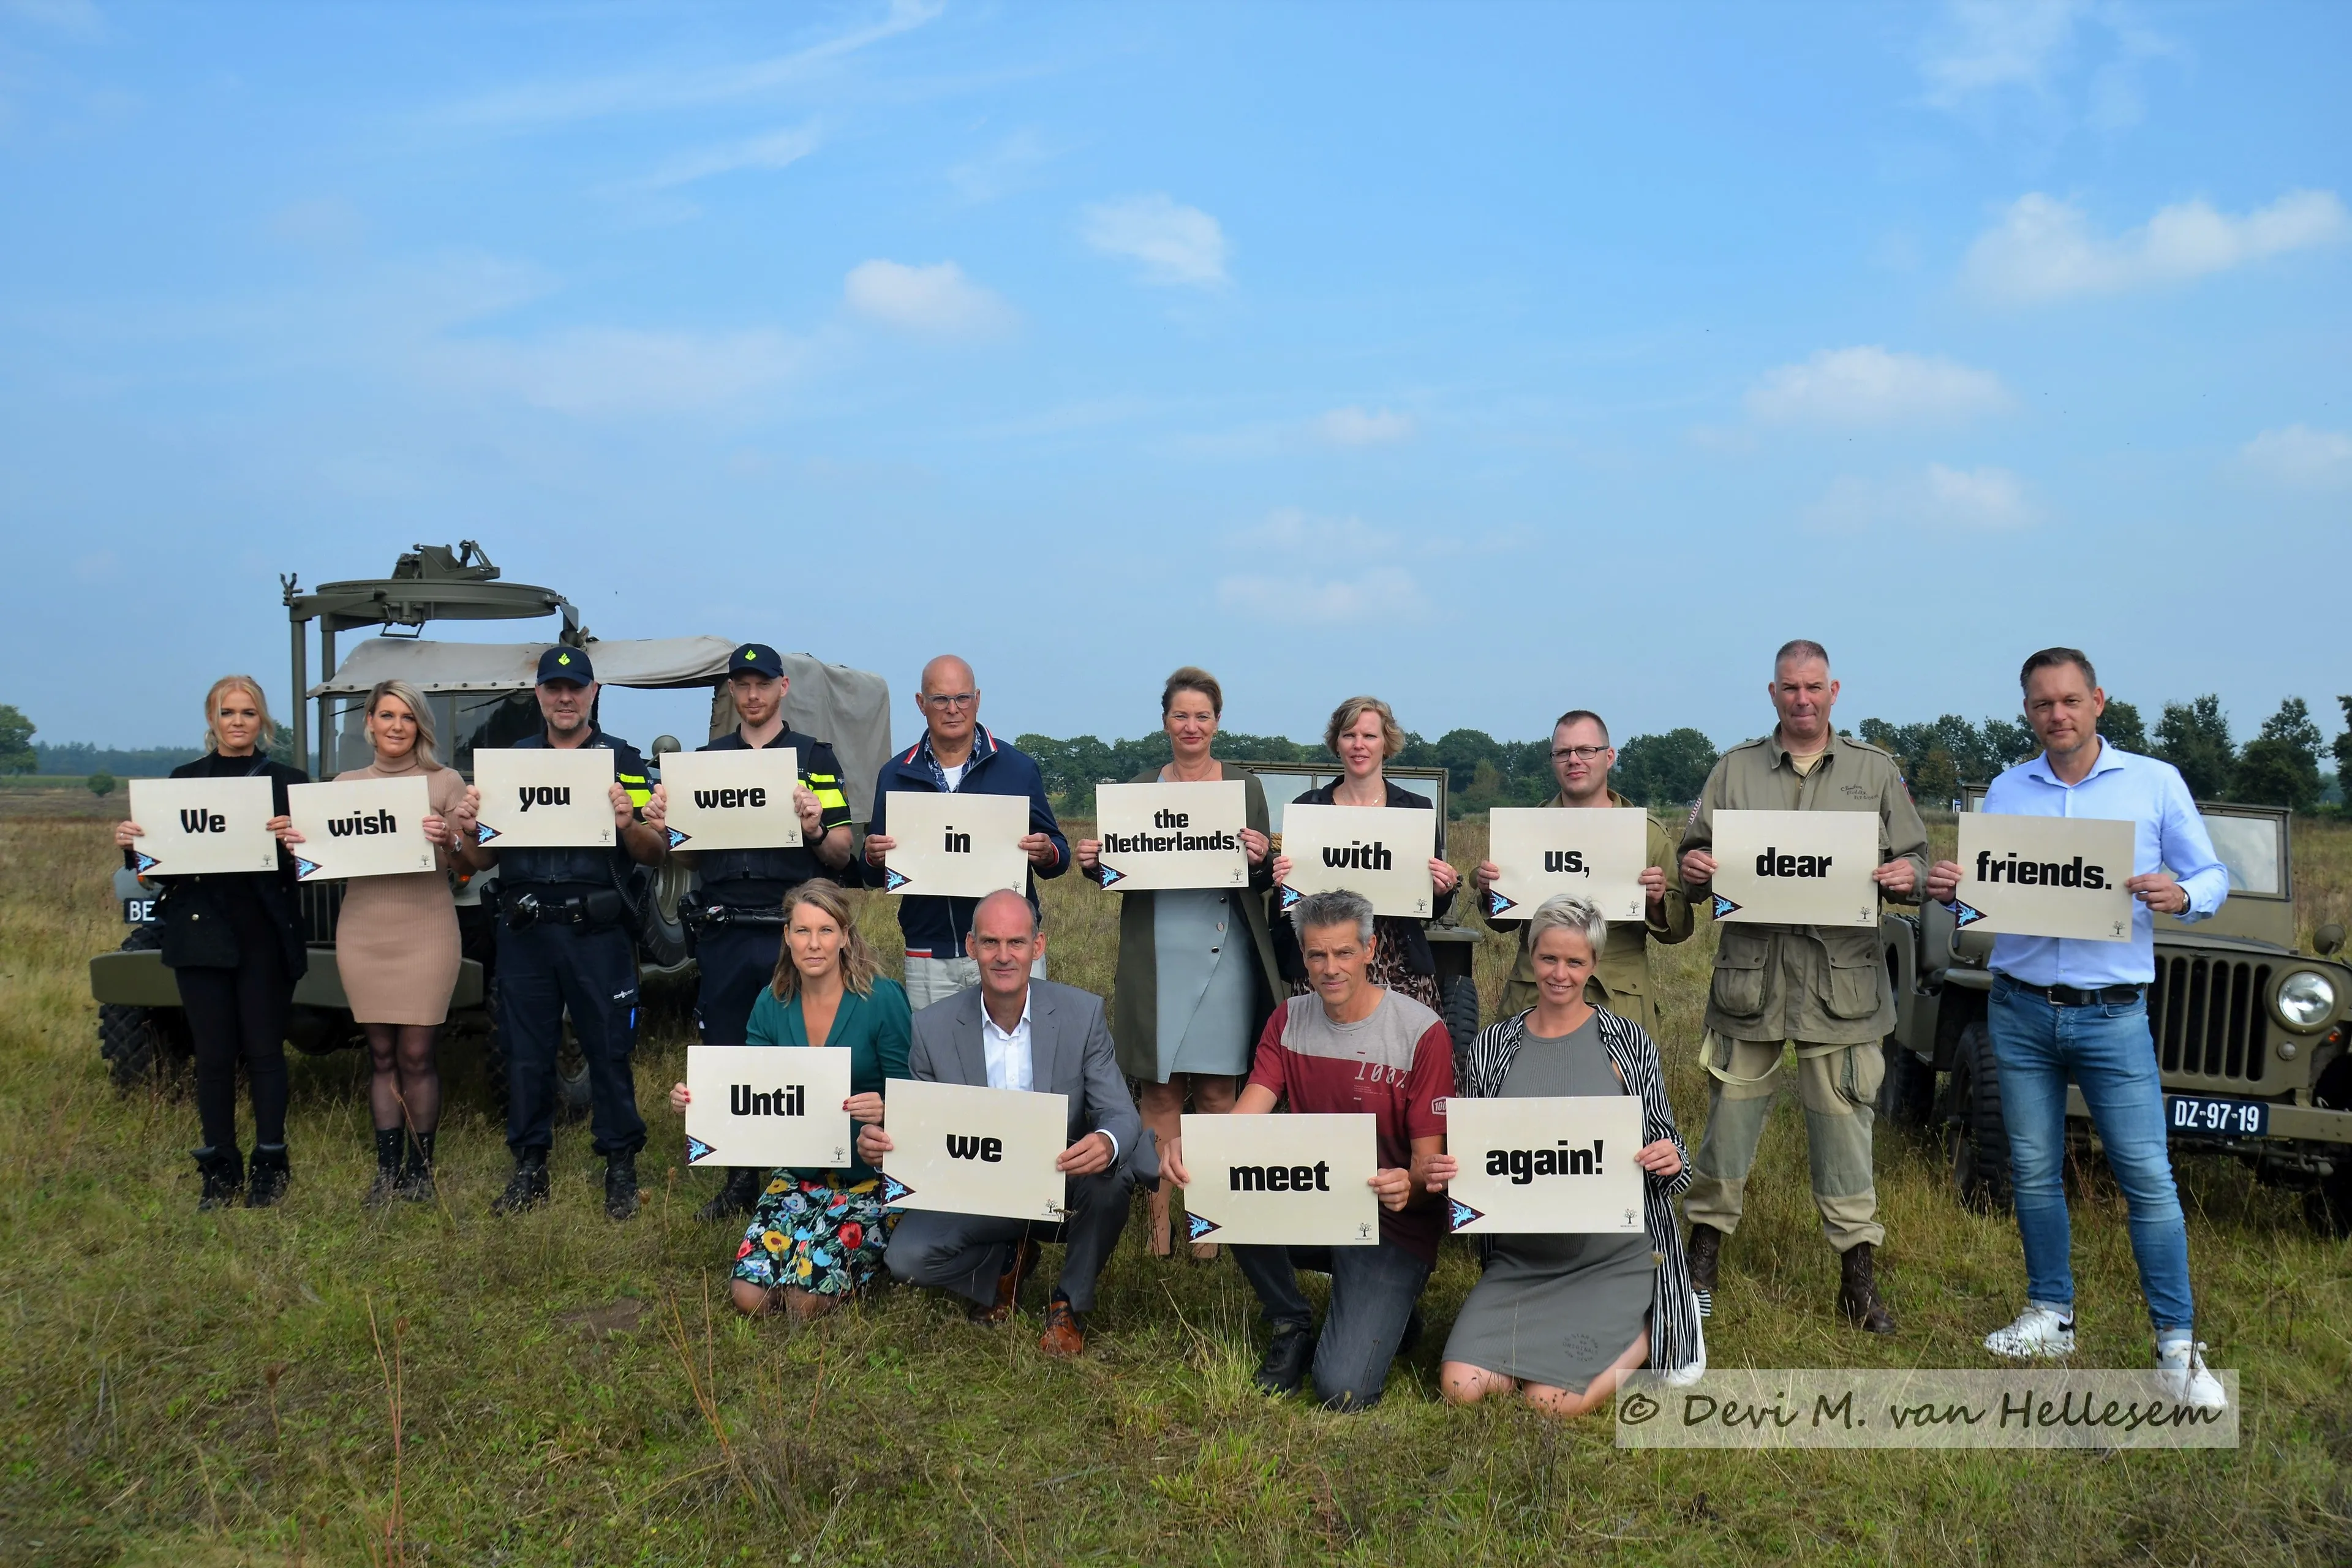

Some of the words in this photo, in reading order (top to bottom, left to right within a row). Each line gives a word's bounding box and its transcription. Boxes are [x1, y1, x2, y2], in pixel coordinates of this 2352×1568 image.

[519, 786, 570, 812] you
[694, 788, 766, 809] were
[180, 809, 226, 834] We
[328, 809, 397, 837] wish
[1153, 809, 1189, 829] the
[945, 825, 971, 853] in
[1104, 830, 1240, 853] Netherlands,
[1322, 840, 1392, 870] with
[1544, 851, 1590, 878] us,
[1756, 846, 1833, 878] dear
[1976, 850, 2112, 890] friends.
[1354, 1061, 1408, 1088] 100%
[731, 1084, 805, 1117] Until
[2174, 1100, 2260, 1133] DZ-97-19
[946, 1134, 1002, 1163] we
[1486, 1139, 1604, 1185] again!
[1229, 1160, 1330, 1191] meet
